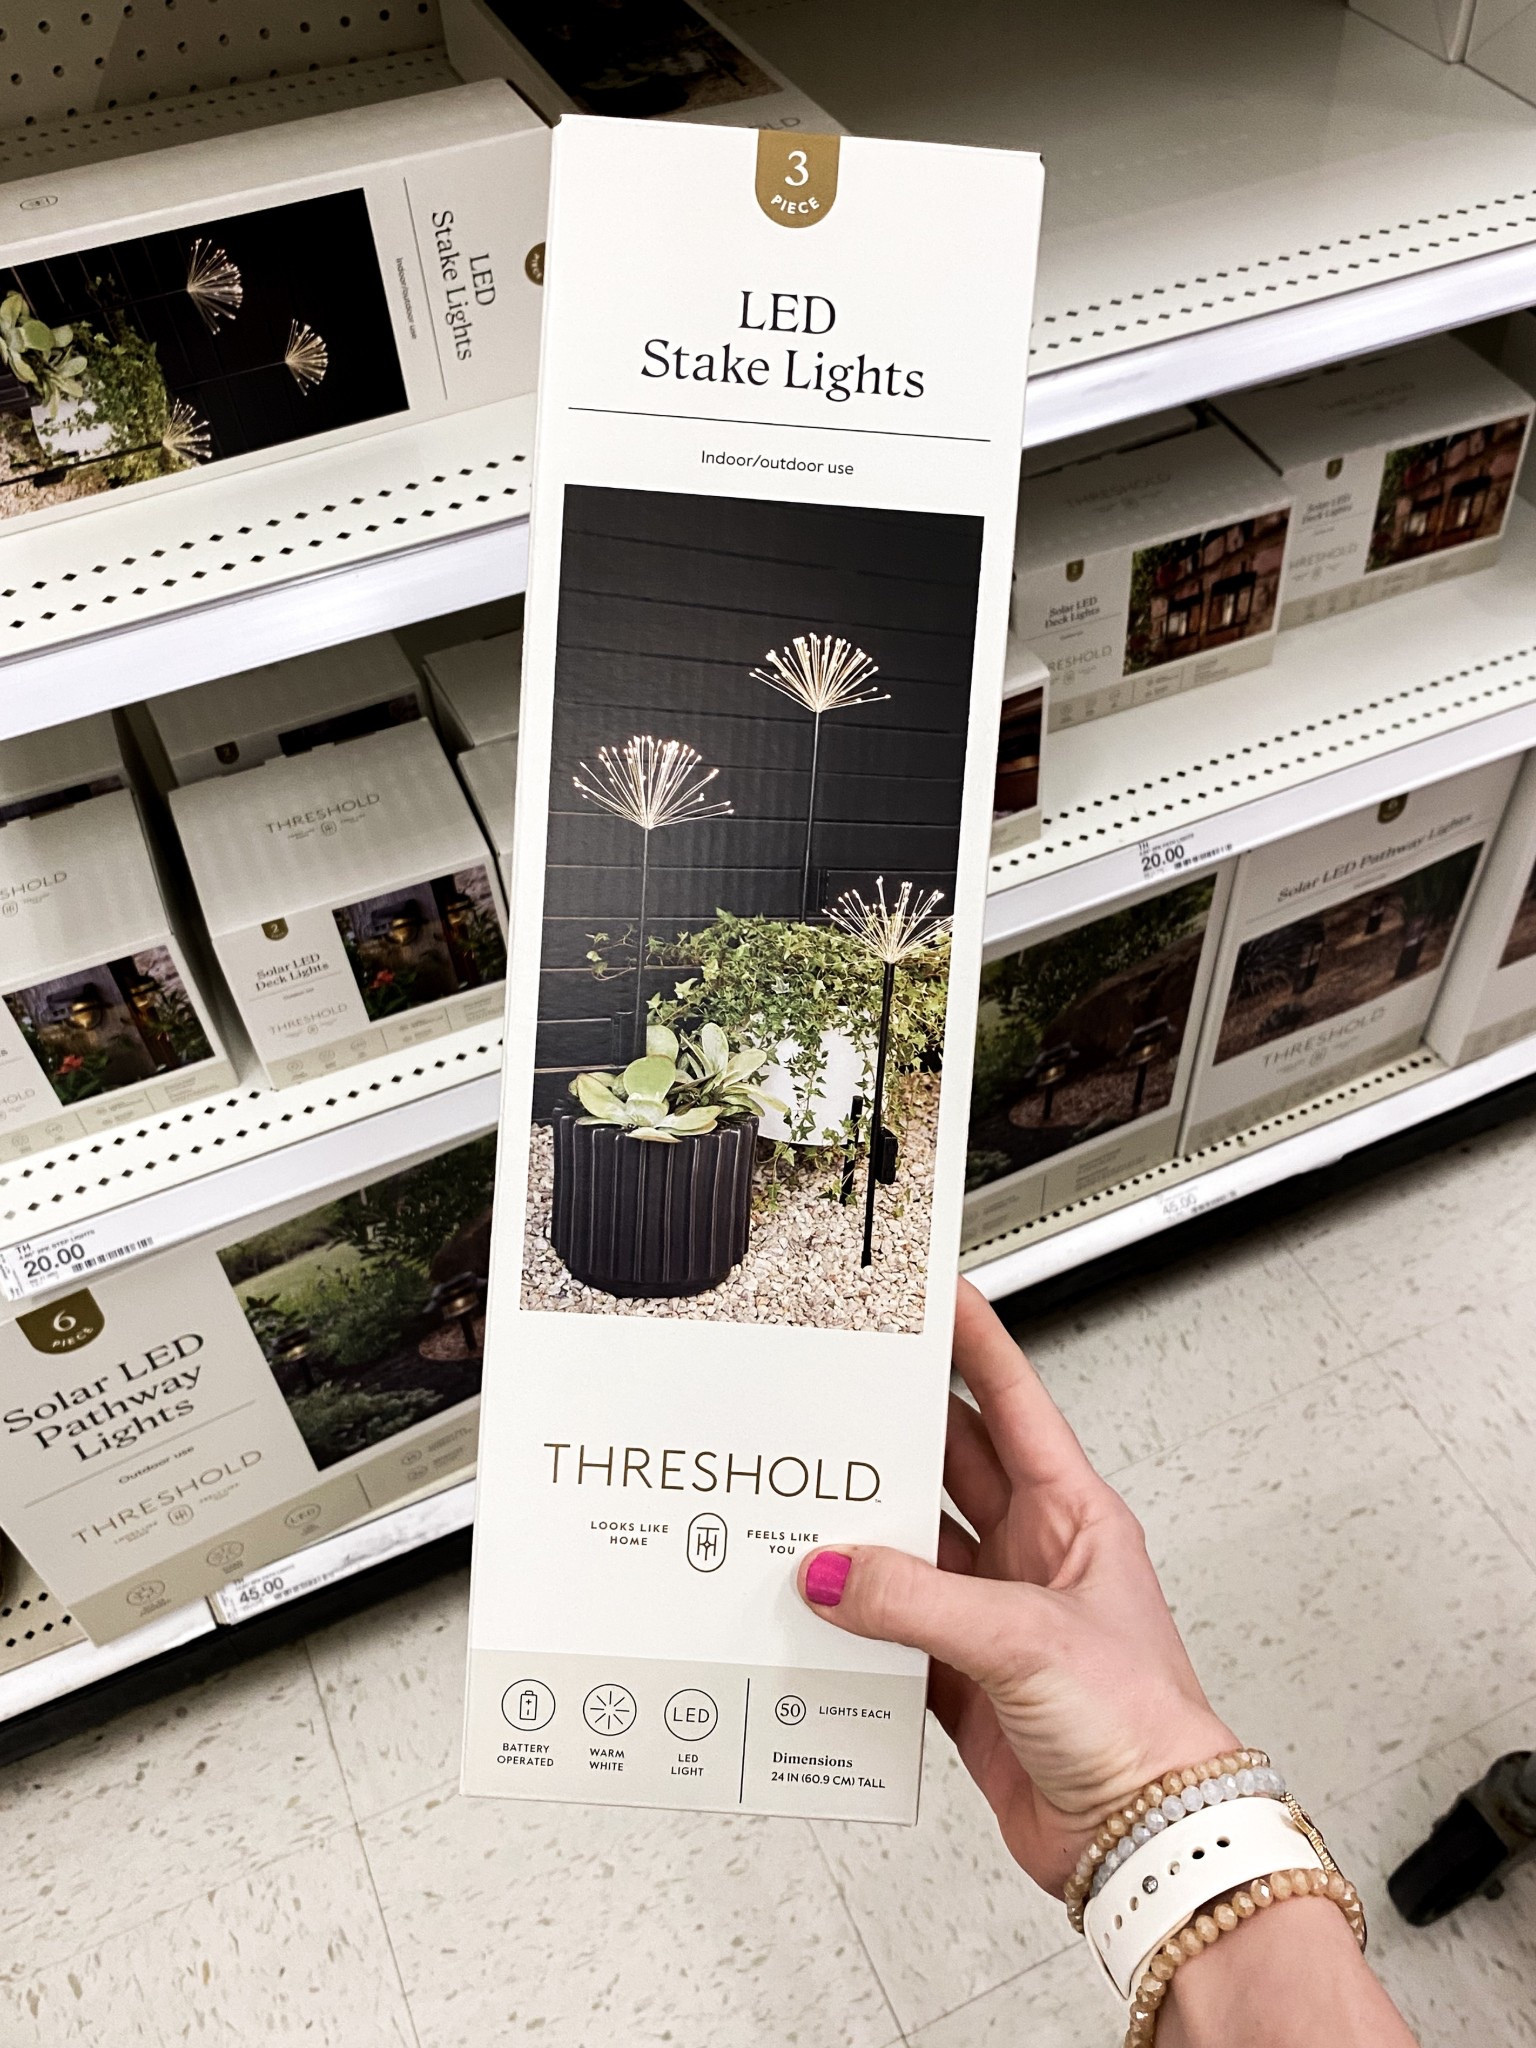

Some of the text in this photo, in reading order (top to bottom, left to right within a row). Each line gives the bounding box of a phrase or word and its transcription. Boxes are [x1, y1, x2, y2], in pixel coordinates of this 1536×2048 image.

[784, 150, 809, 186] 3
[770, 194, 820, 215] PIECE
[432, 210, 473, 361] Stake Lights
[469, 252, 496, 307] LED
[738, 290, 837, 335] LED
[640, 338, 925, 403] Stake Lights
[701, 450, 854, 476] Indoor/outdoor use
[265, 793, 380, 834] THRESHOLD
[1141, 844, 1185, 872] 20.00
[1277, 875, 1318, 902] Solar
[1322, 860, 1358, 884] LED
[1358, 834, 1427, 869] Pathway
[1428, 813, 1473, 839] Lights
[270, 923, 280, 934] 2
[254, 961, 330, 992] Deck Lights
[256, 952, 321, 981] Solar LED
[268, 1002, 349, 1036] THRESHOLD
[1264, 1005, 1386, 1068] THRESHOLD
[23, 1243, 86, 1278] 20.00
[53, 1310, 77, 1332] 6
[52, 1326, 94, 1348] PIECE
[2, 1333, 204, 1434] Solar LED
[32, 1365, 201, 1450] Pathway
[72, 1399, 195, 1462] Lights
[118, 1446, 195, 1485] Outdoor use
[543, 1442, 881, 1503] THRESHOLD
[71, 1449, 263, 1544] THRESHOLD
[591, 1521, 669, 1534] LOOKS LIKE
[609, 1535, 648, 1546] HOME
[747, 1529, 820, 1543] FEELS LIKE
[769, 1544, 795, 1555] YOU
[240, 1576, 285, 1603] 45.00
[673, 1706, 710, 1724] LED
[780, 1703, 891, 1720] 50 LIGHTS EACH
[496, 1755, 554, 1767] OPERATED
[502, 1742, 550, 1755] BATTERY
[589, 1748, 625, 1759] WARM
[678, 1753, 699, 1763] LED
[772, 1751, 853, 1769] Dimensions
[589, 1761, 624, 1772] WHITE
[671, 1766, 704, 1777] LIGHT
[771, 1771, 886, 1789] 24 IN (60.9 CM) TALL
